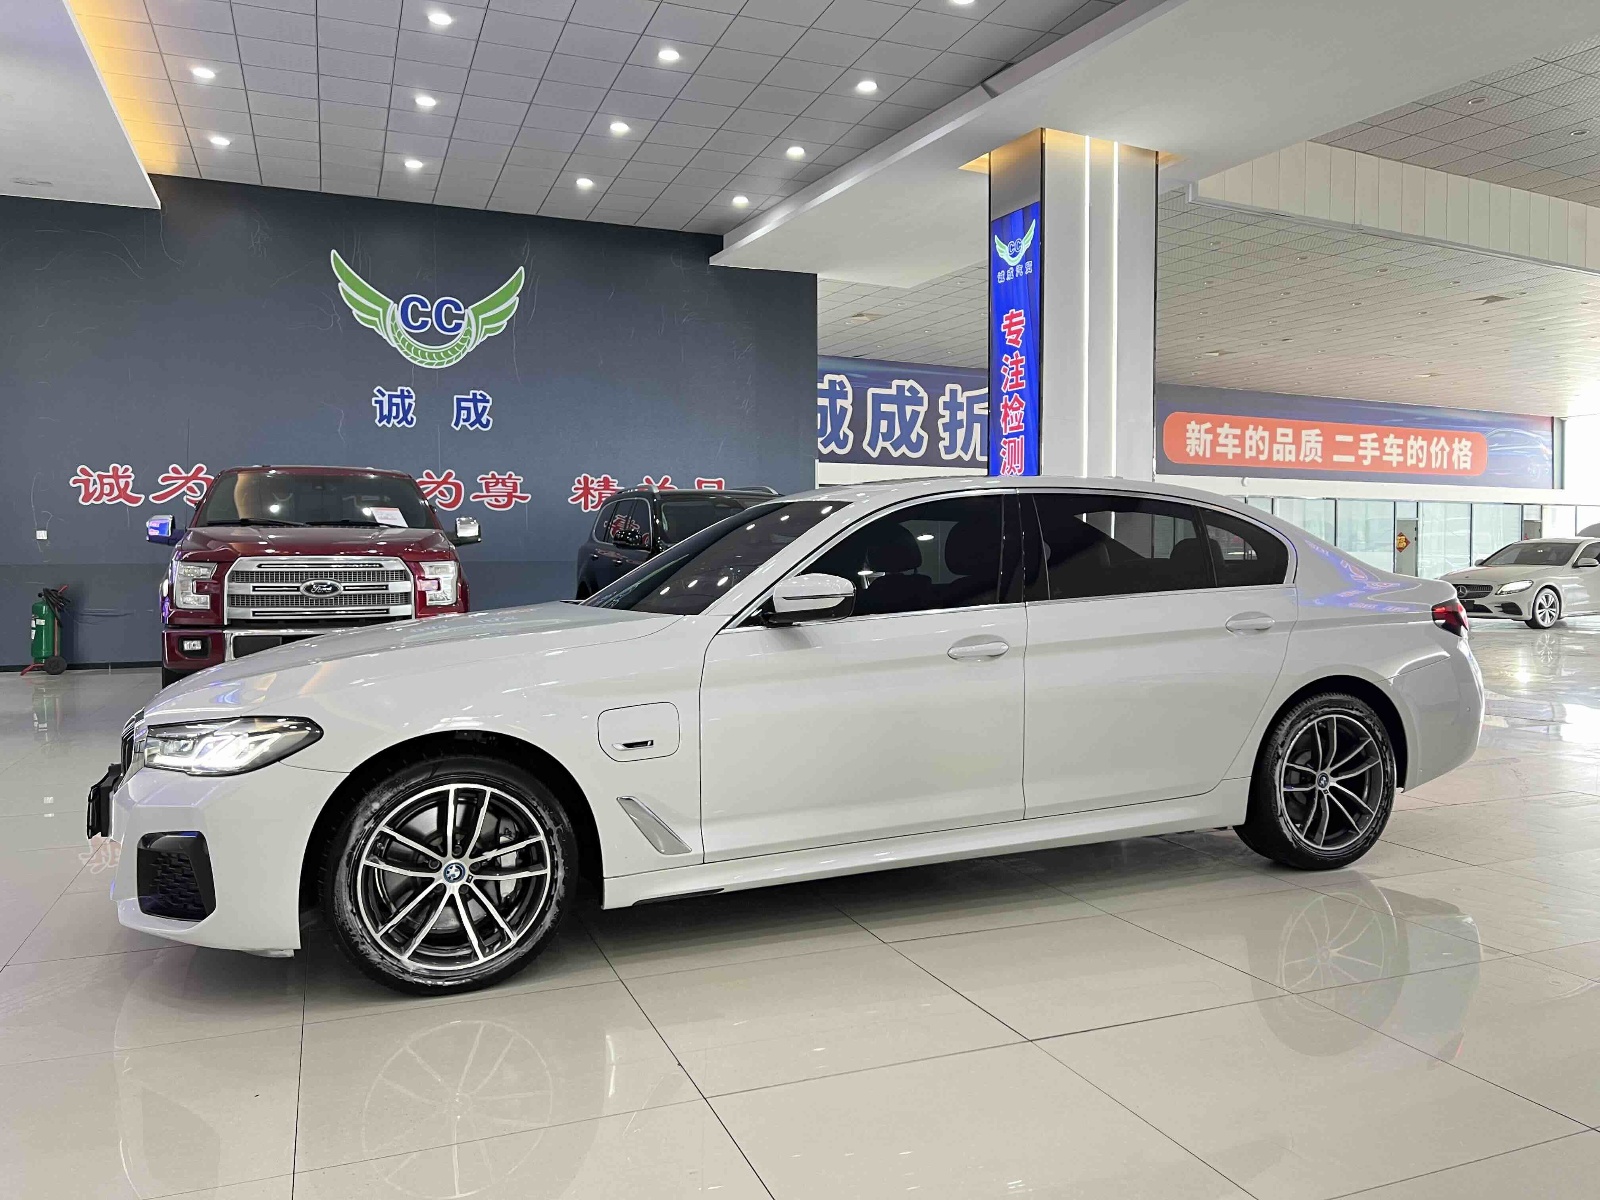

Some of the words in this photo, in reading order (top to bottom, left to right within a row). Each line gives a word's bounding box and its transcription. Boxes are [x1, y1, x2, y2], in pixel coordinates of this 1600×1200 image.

[399, 294, 465, 335] CC
[1001, 308, 1026, 475] 专注检测
[1185, 420, 1324, 464] 新车的品质
[1332, 432, 1473, 471] 二手车的价格
